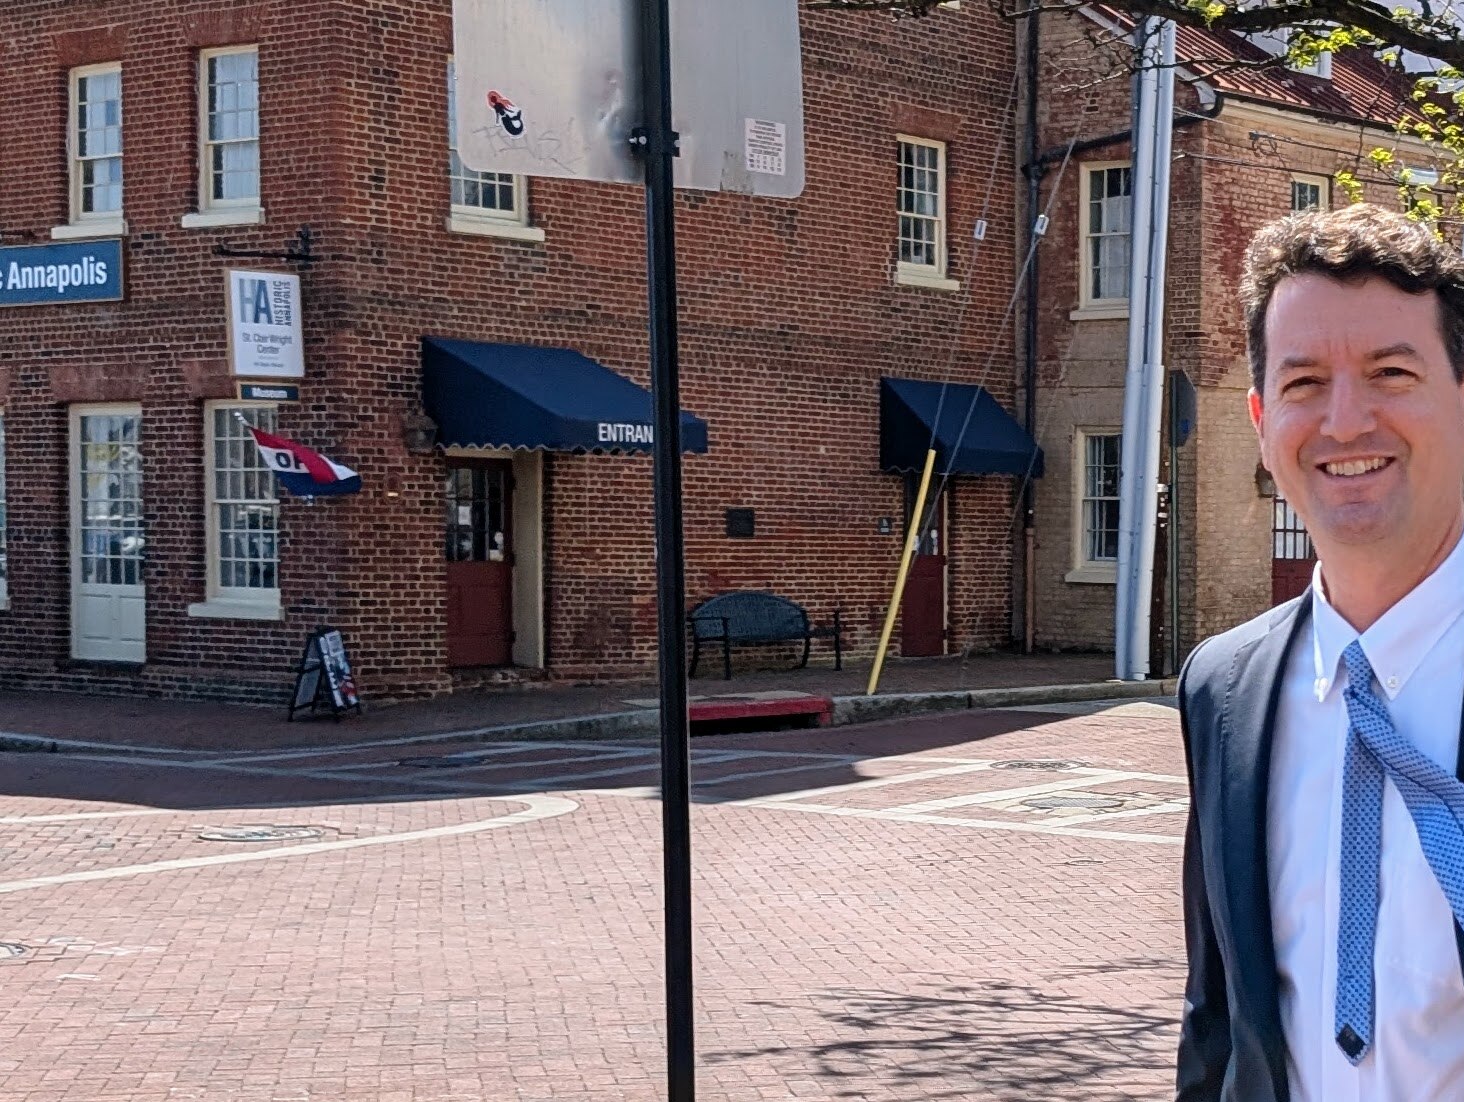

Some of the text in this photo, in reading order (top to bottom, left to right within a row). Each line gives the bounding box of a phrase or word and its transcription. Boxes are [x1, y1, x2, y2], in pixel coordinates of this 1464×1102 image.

[7, 256, 107, 293] Annapolis
[239, 278, 273, 324] HA
[273, 280, 284, 326] HISTORIC
[282, 281, 292, 327] ANNAPOLIS
[598, 423, 654, 443] ENTRAN
